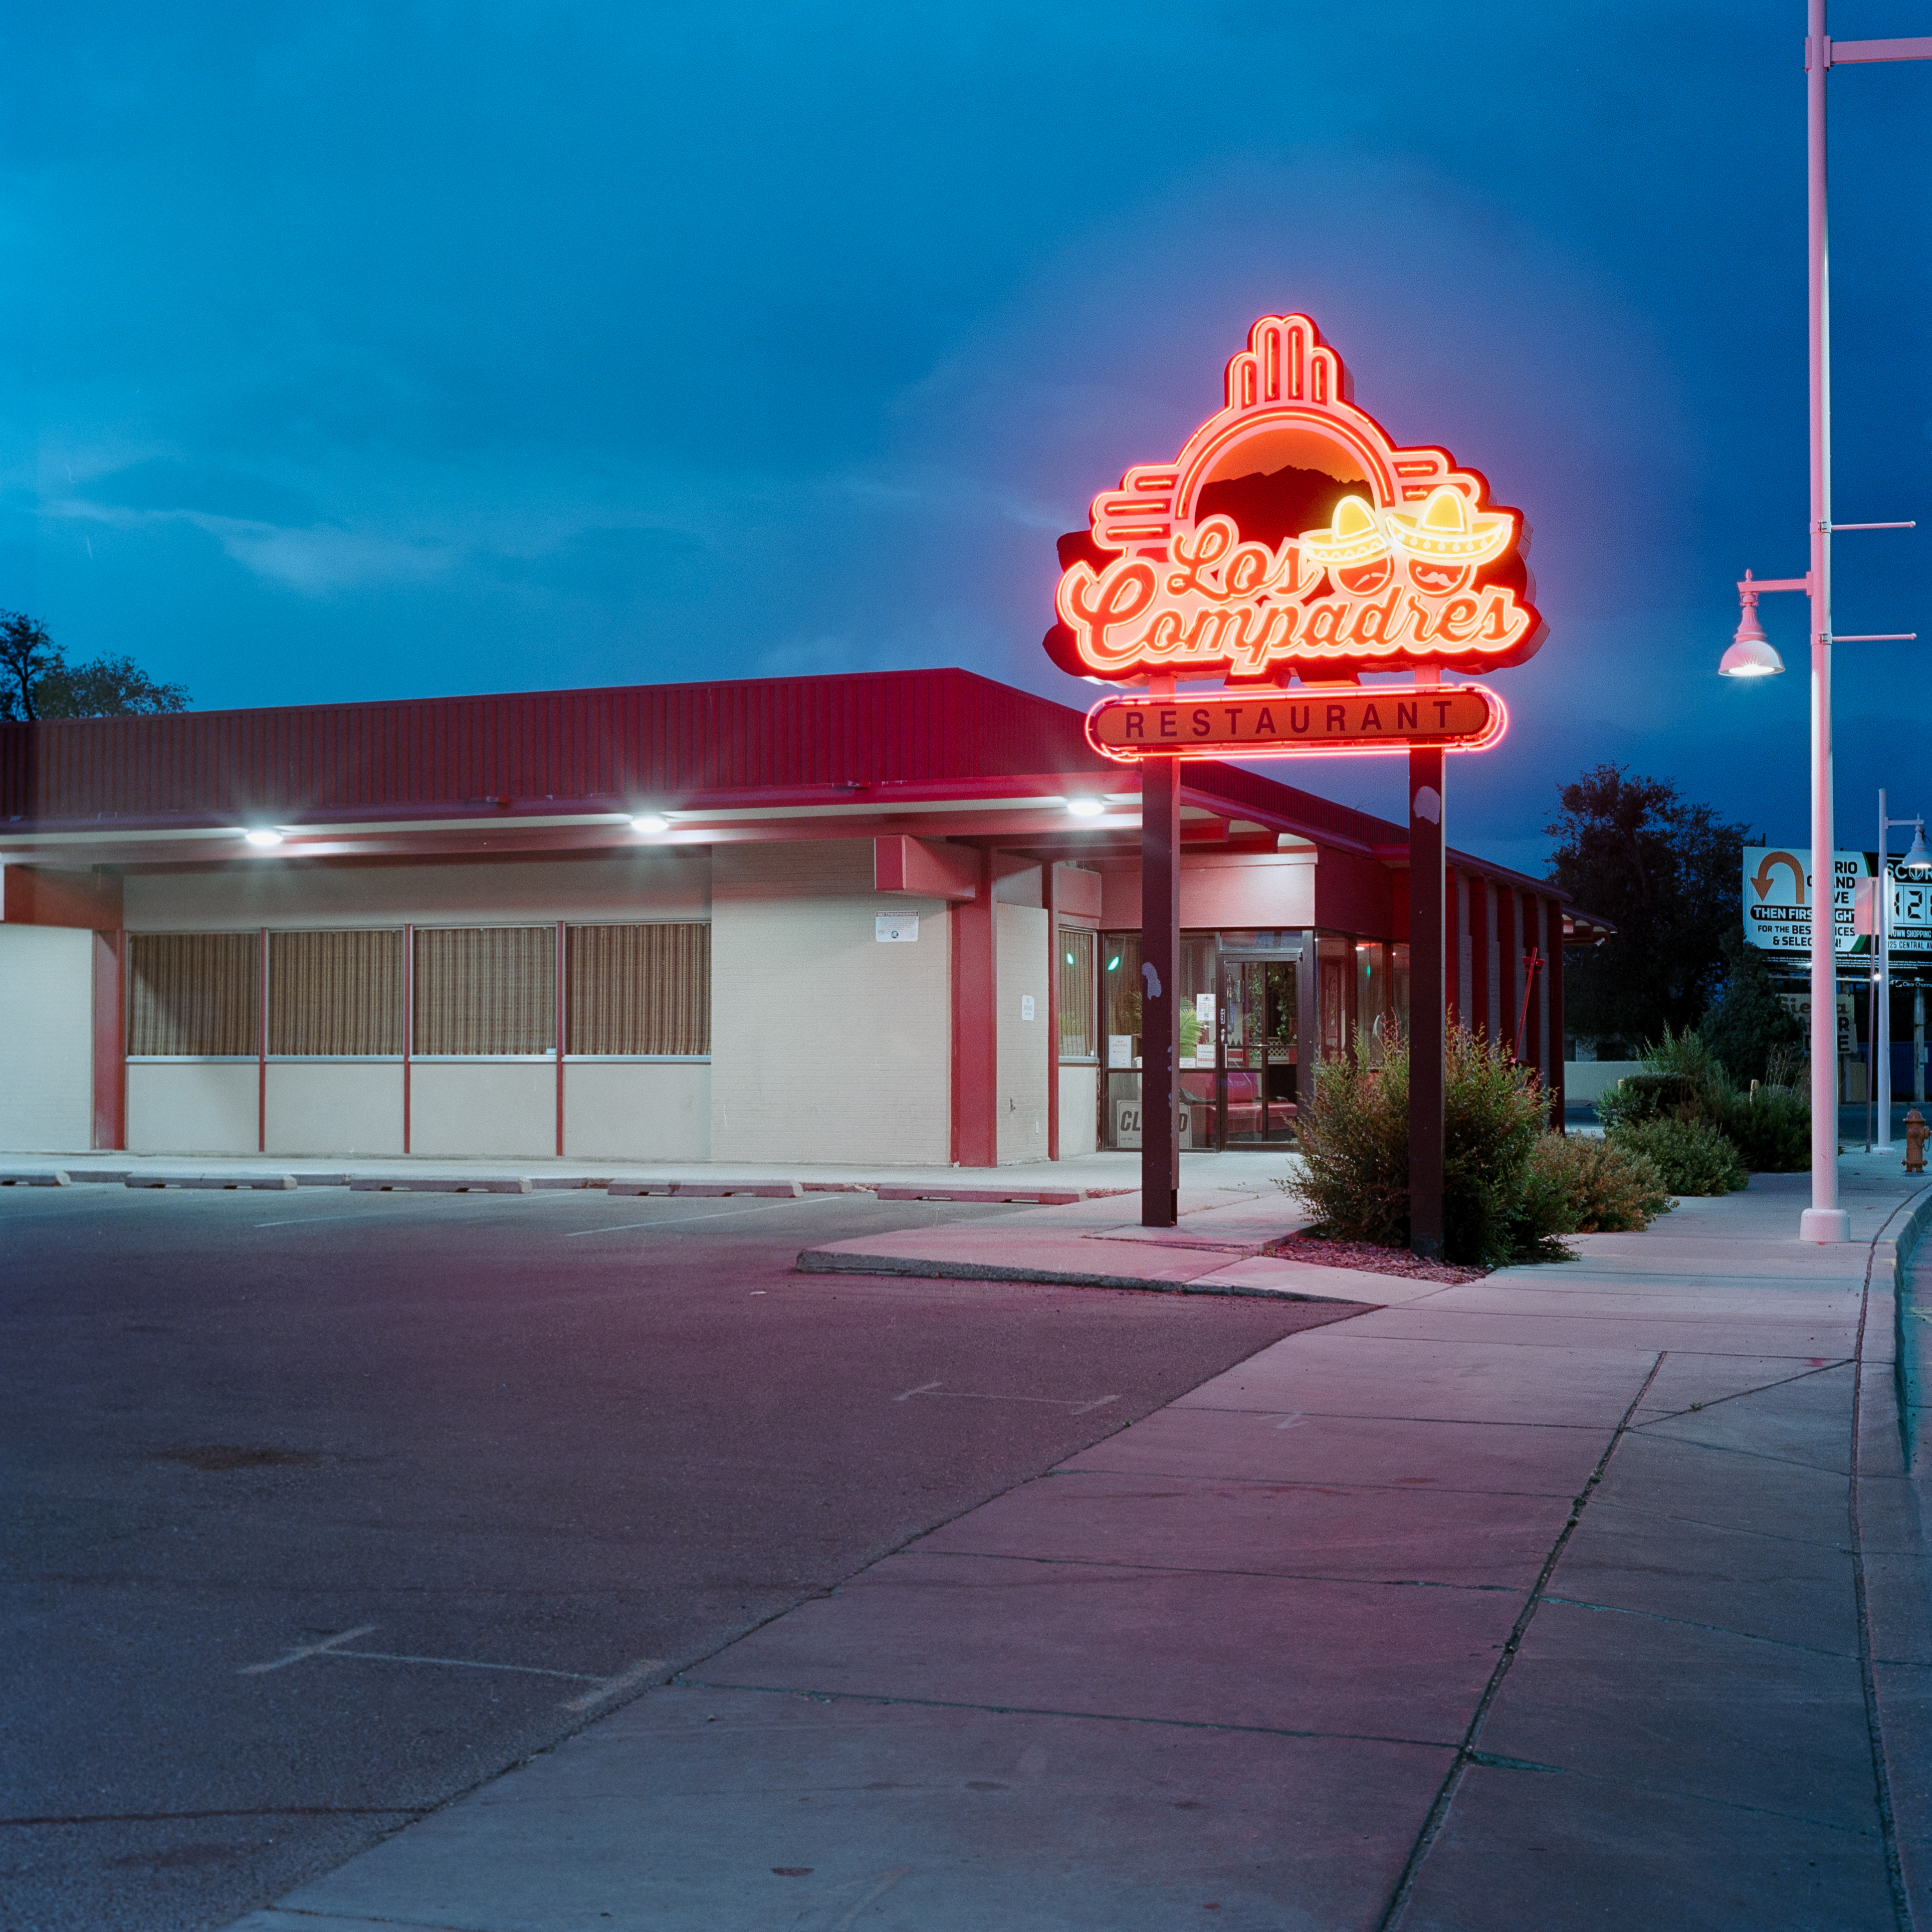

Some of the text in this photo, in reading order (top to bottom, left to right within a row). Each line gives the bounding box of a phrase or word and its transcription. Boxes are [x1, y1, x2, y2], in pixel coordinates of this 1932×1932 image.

[1165, 520, 1320, 604] Los
[1067, 560, 1526, 667] Compadres
[1126, 701, 1452, 738] RESTAURANT
[1834, 861, 1858, 875] RIO
[1834, 891, 1849, 904] VE
[1754, 907, 1812, 920] THEN FIRS
[1758, 925, 1773, 933] FOR
[1792, 925, 1812, 935] BES
[1890, 929, 1931, 938] OWN SHOPPING
[1773, 936, 1780, 946] &
[1899, 941, 1924, 949] CENTRAL
[1120, 1111, 1188, 1132] CLD
